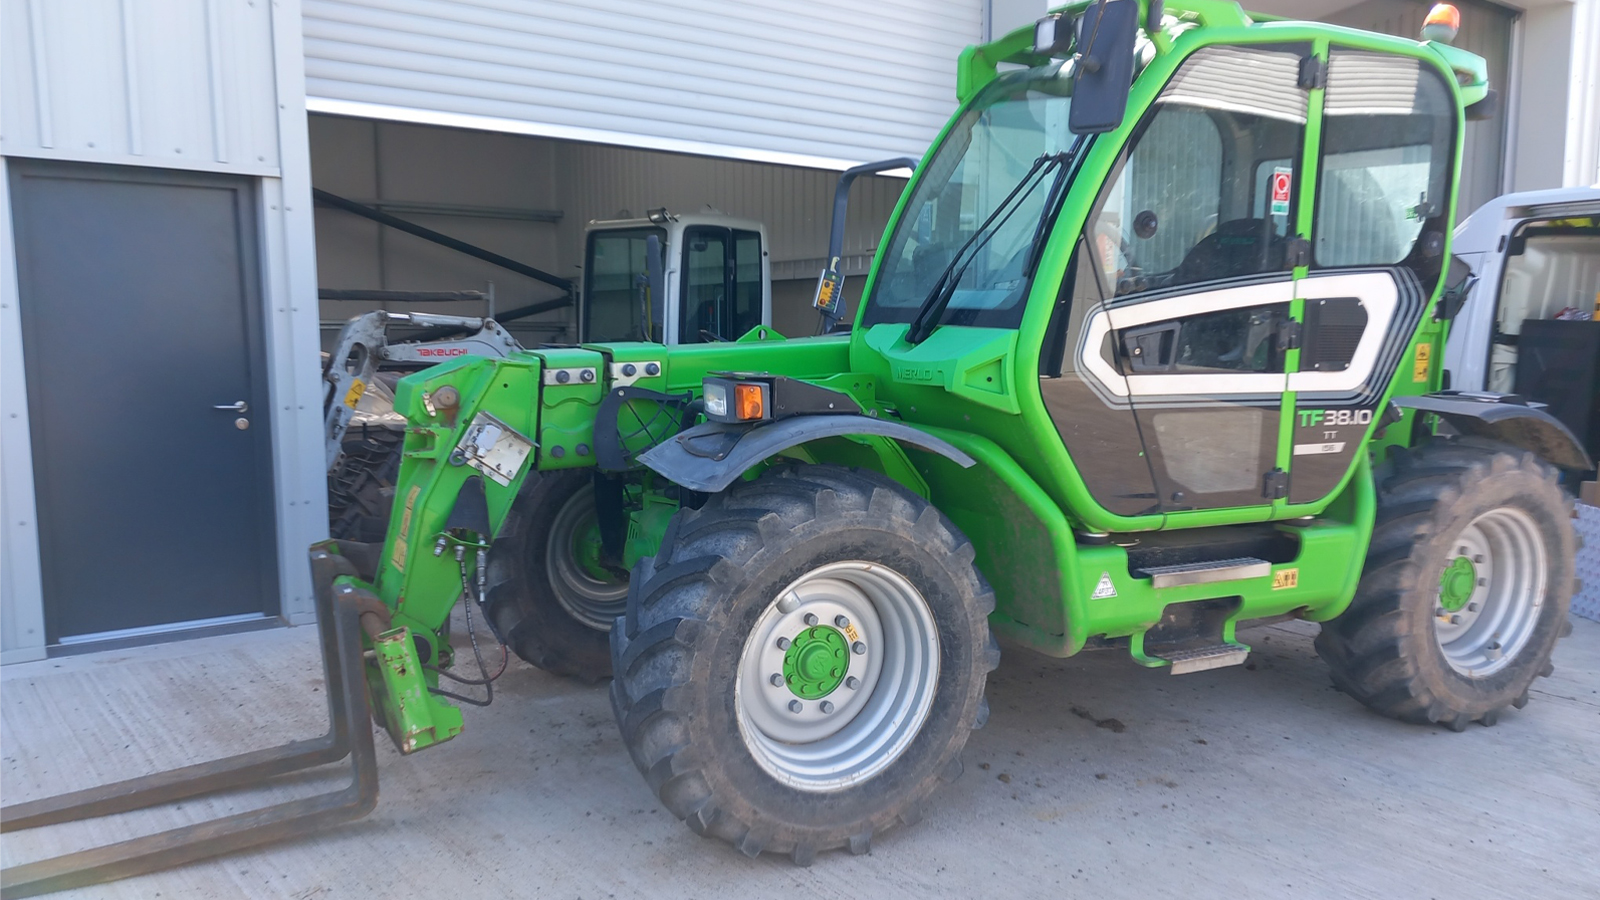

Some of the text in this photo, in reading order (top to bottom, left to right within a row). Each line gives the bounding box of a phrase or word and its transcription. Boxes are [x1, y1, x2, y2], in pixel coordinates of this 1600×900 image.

[897, 367, 932, 380] MERLO
[1298, 410, 1372, 427] TF38.10
[1323, 431, 1339, 439] TT
